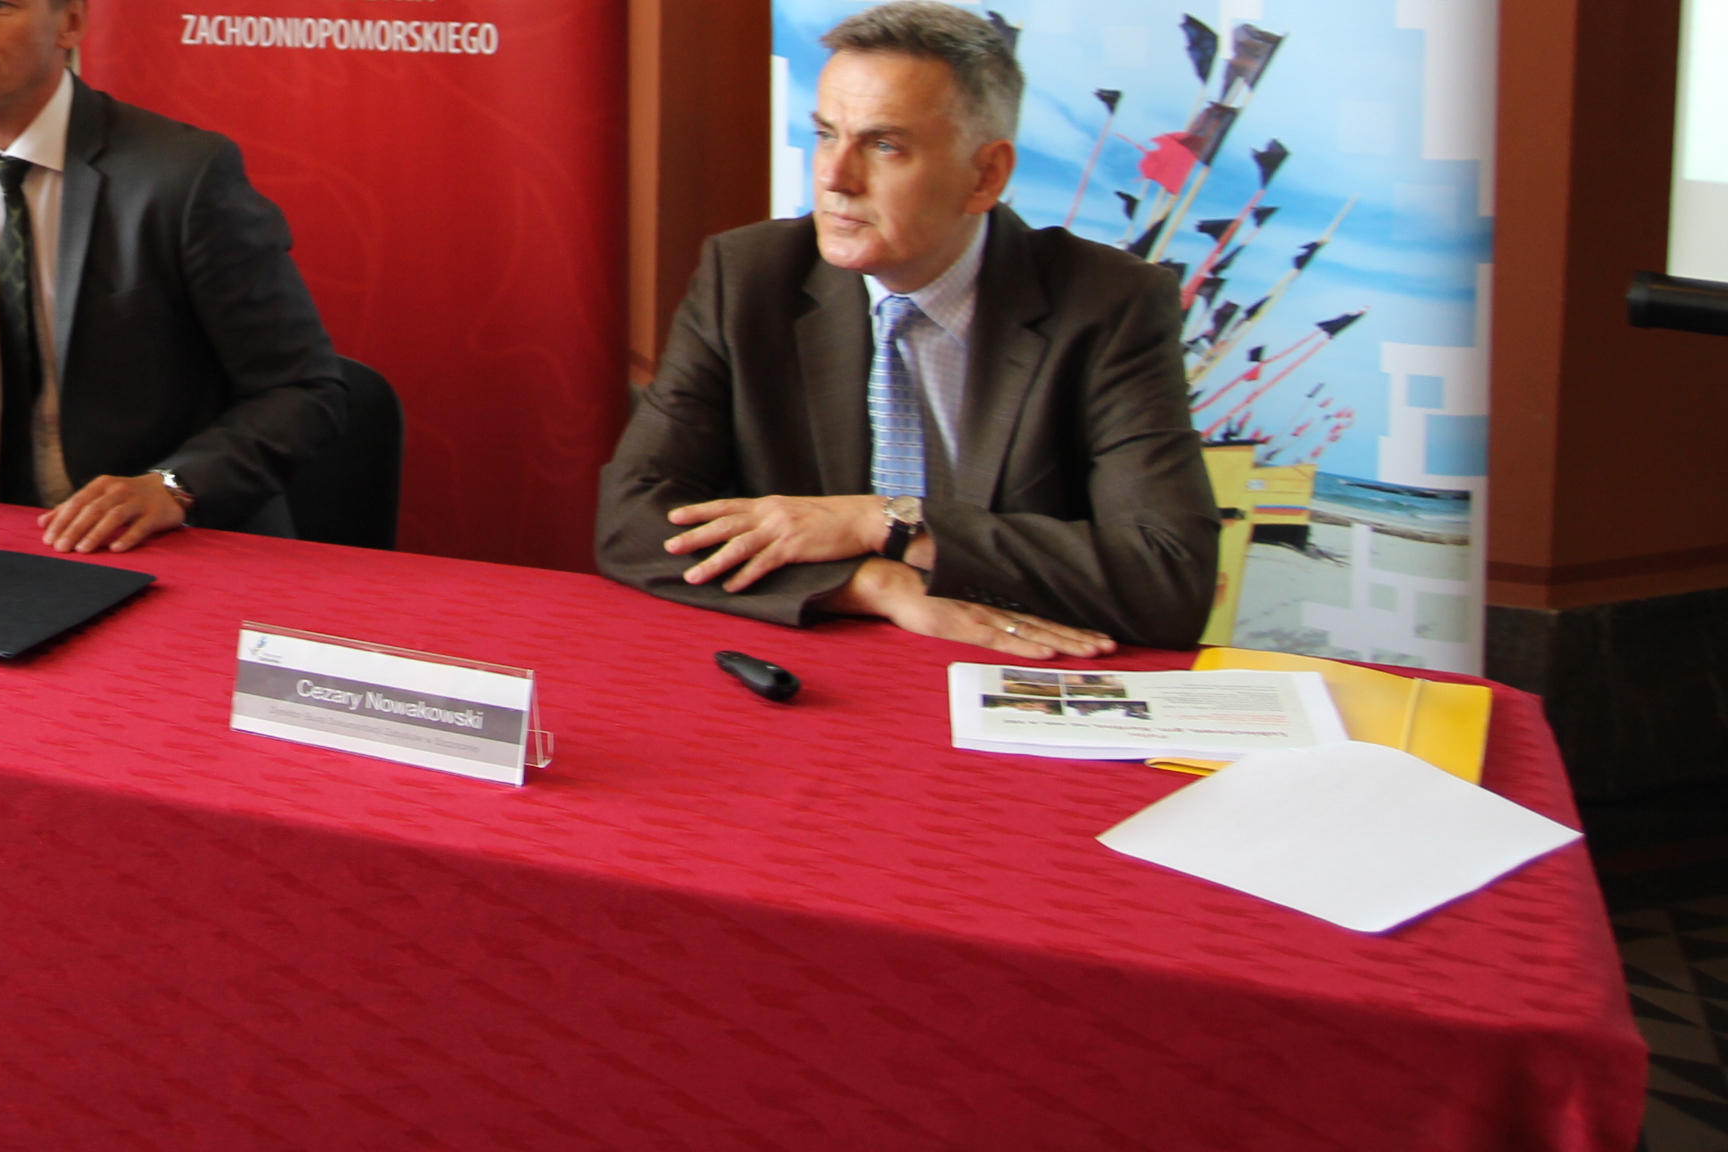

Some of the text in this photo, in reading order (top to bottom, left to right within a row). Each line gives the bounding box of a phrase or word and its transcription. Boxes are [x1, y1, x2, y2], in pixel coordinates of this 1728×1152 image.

[180, 14, 499, 55] ZACHODNIOPOMORSKIEGO
[295, 677, 486, 731] Cezary Nowakowski
